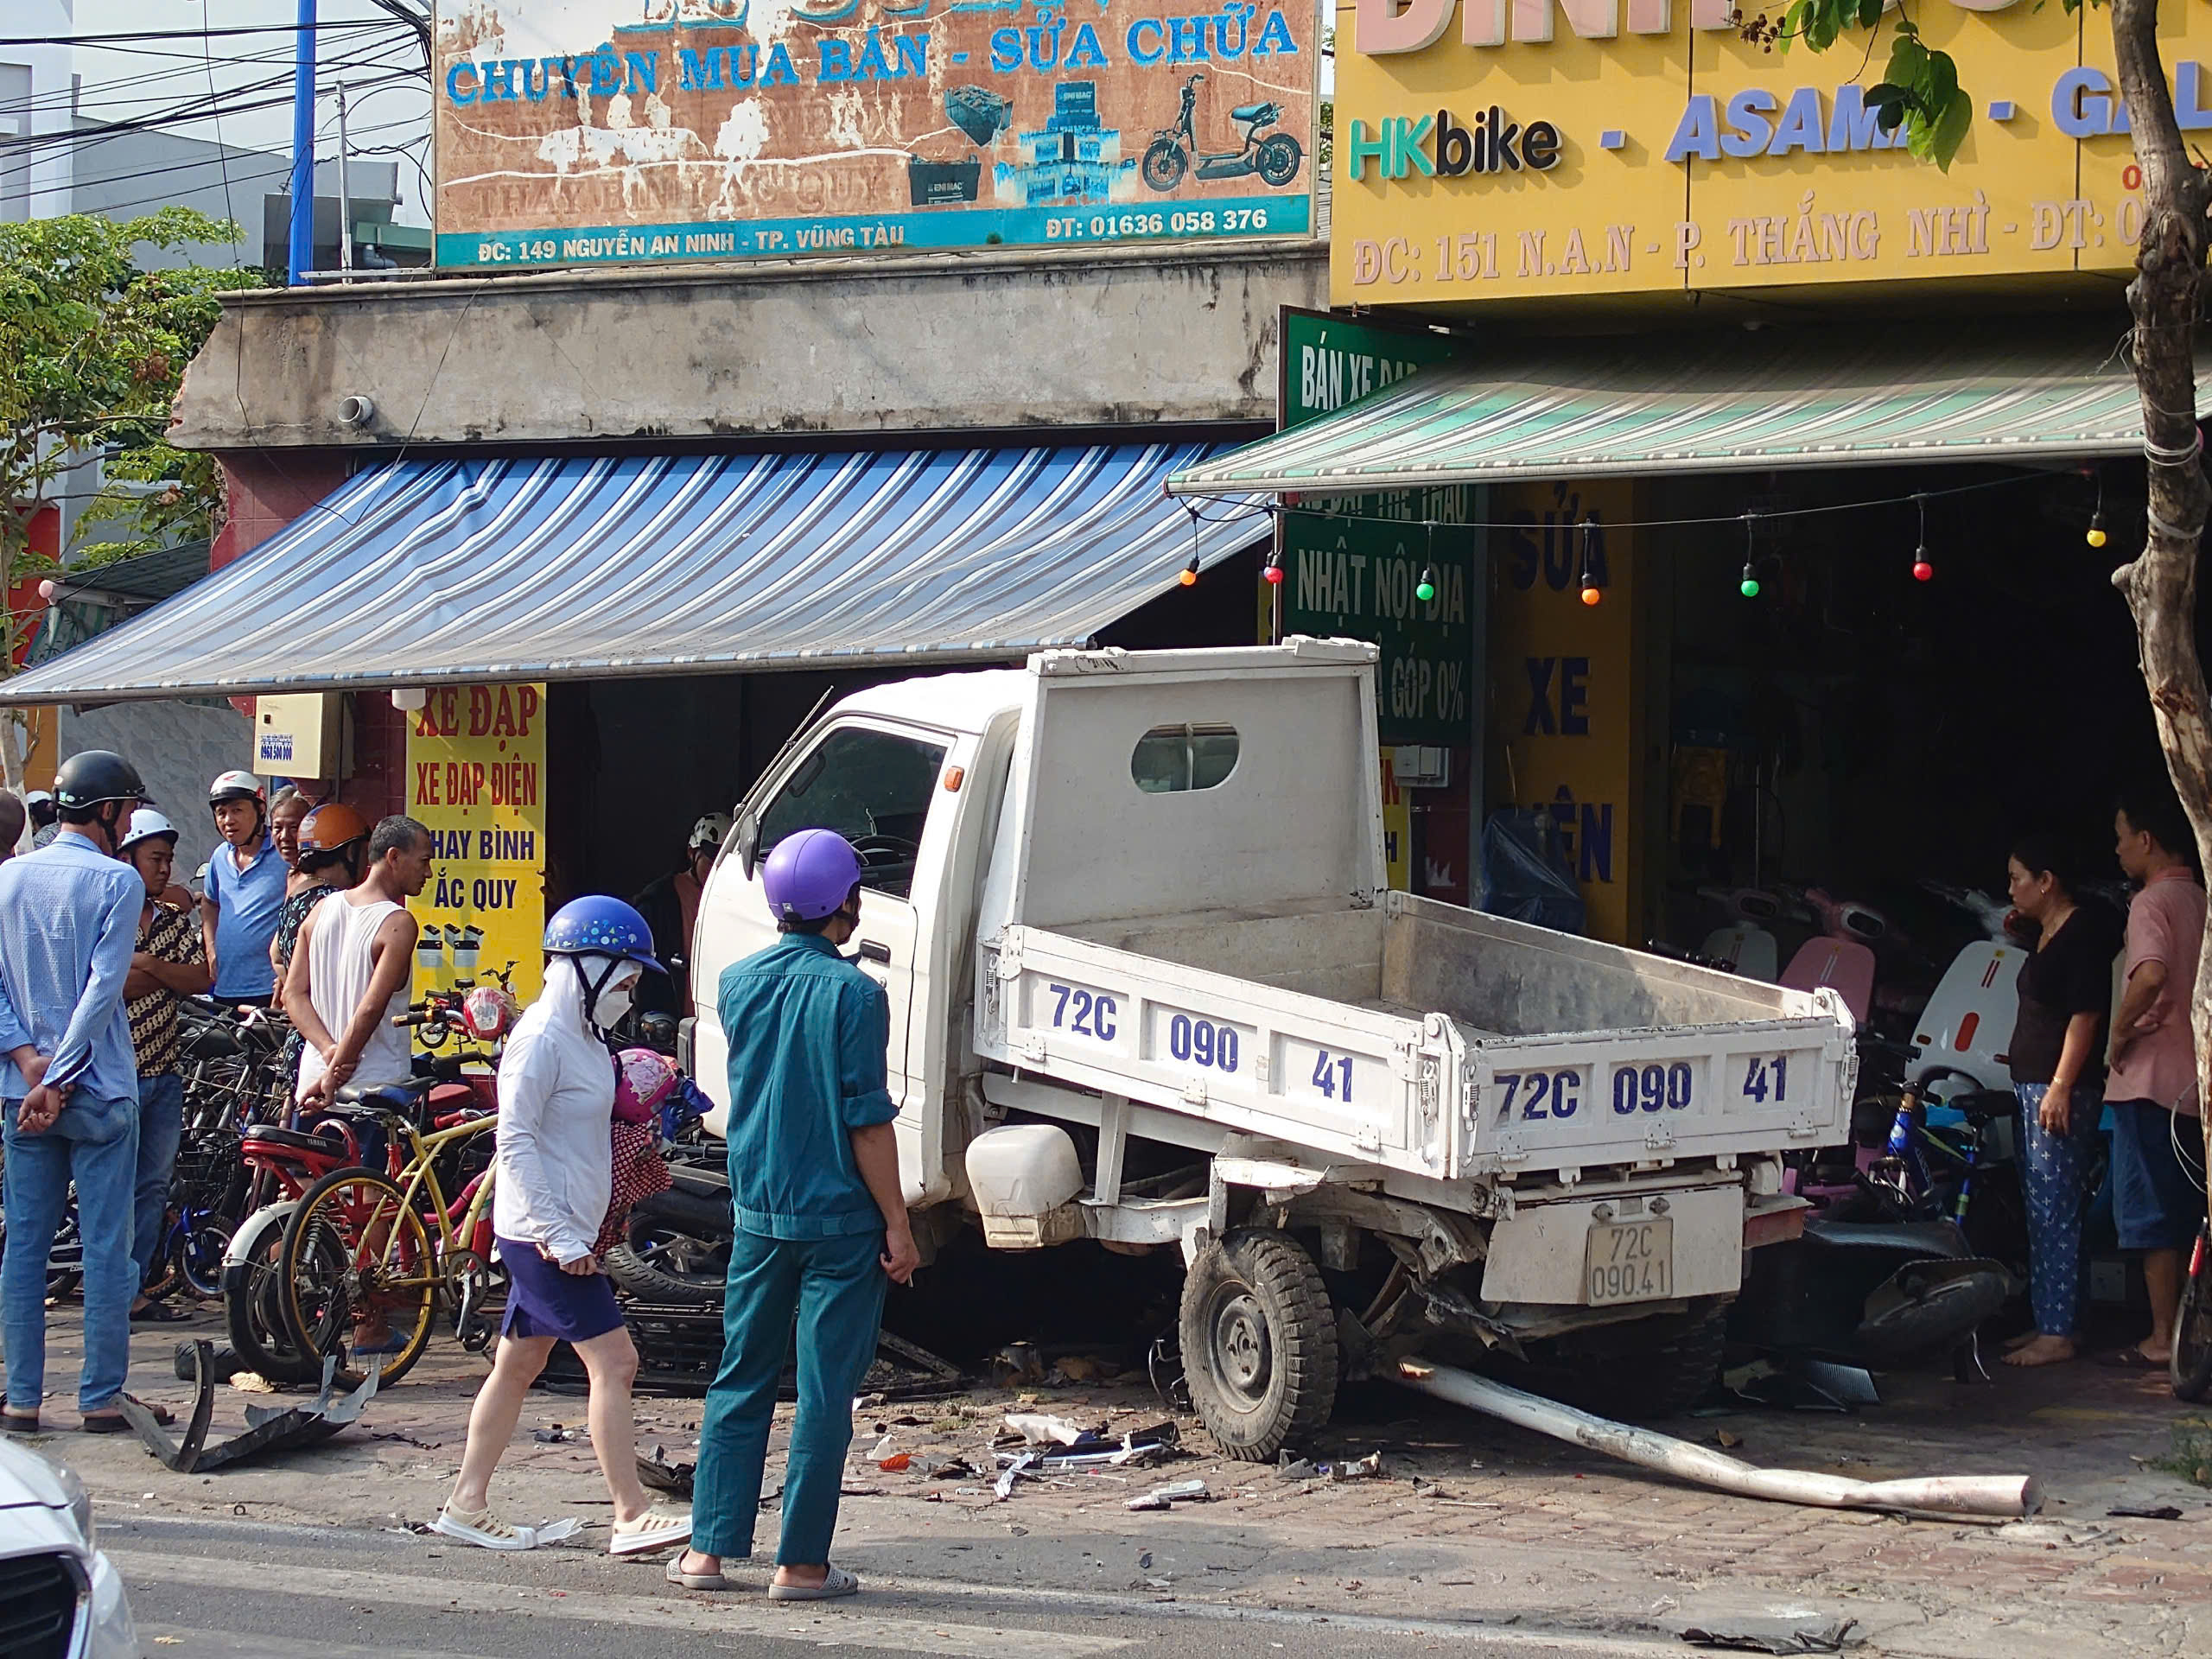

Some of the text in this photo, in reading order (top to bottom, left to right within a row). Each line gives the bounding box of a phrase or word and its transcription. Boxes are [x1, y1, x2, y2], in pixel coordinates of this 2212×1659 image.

[446, 41, 662, 107] CHUYÊN
[678, 40, 800, 90] MUA
[817, 24, 930, 83] BÁN
[988, 10, 1108, 74] SỬA
[1125, 2, 1298, 67] CHỮA
[1349, 105, 1562, 181] HKbike
[1664, 85, 1909, 162] ASAM
[478, 244, 512, 262] ĐC:
[518, 241, 556, 261] 149
[563, 226, 646, 257] NGUYỄN
[651, 236, 681, 255] AN
[684, 232, 734, 253] NINH
[754, 232, 788, 251] TP.
[795, 226, 855, 249] VŨNG
[858, 225, 905, 247] TÀU
[1046, 207, 1268, 239] ĐT: 01636 058 376
[1352, 236, 1421, 284] ĐC:
[1434, 232, 1500, 281] 151
[1516, 225, 1636, 277] N.A.N
[1674, 219, 1707, 269] P.
[1728, 188, 1880, 264] THẮNG
[1906, 188, 1990, 257] NHÌ
[2030, 200, 2105, 251] ĐT:
[1302, 330, 1343, 411] BÁN
[1297, 536, 1366, 627] NHẬT
[1375, 542, 1416, 632] NỘI
[1391, 642, 1431, 719] GÓP
[1437, 660, 1464, 722] 0%
[1523, 657, 1590, 735] XE
[416, 684, 538, 753] XE ĐẠP
[416, 752, 537, 817] XE ĐẠP ĐIỆN
[429, 823, 535, 861] HAY BÌNH
[435, 867, 518, 912] ẮC QUY
[1049, 982, 1353, 1103] 72C 090 41
[1493, 1055, 1788, 1122] 72C 090 41
[1611, 1225, 1653, 1262] 72C
[1592, 1259, 1665, 1299] 090.41
